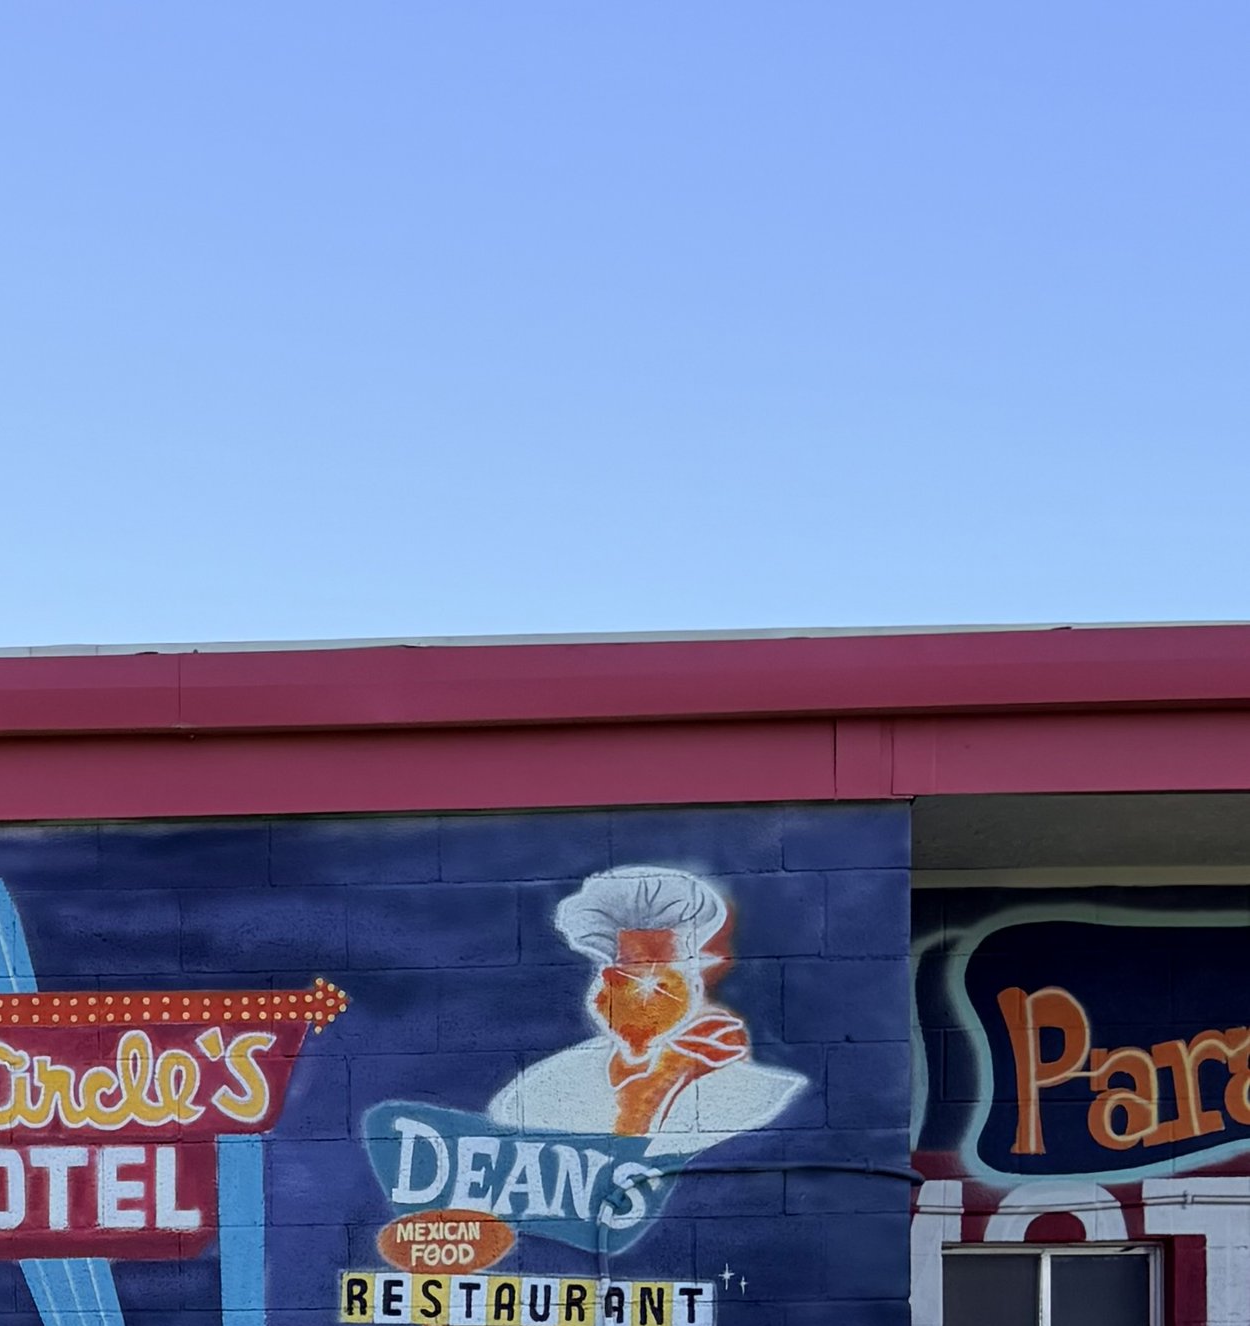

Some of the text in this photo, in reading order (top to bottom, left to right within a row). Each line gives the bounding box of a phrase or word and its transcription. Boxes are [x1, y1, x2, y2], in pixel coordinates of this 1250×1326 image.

[396, 1221, 481, 1243] MEXICAN
[410, 1244, 475, 1267] FOOD
[344, 1276, 704, 1326] RESTAURANT
